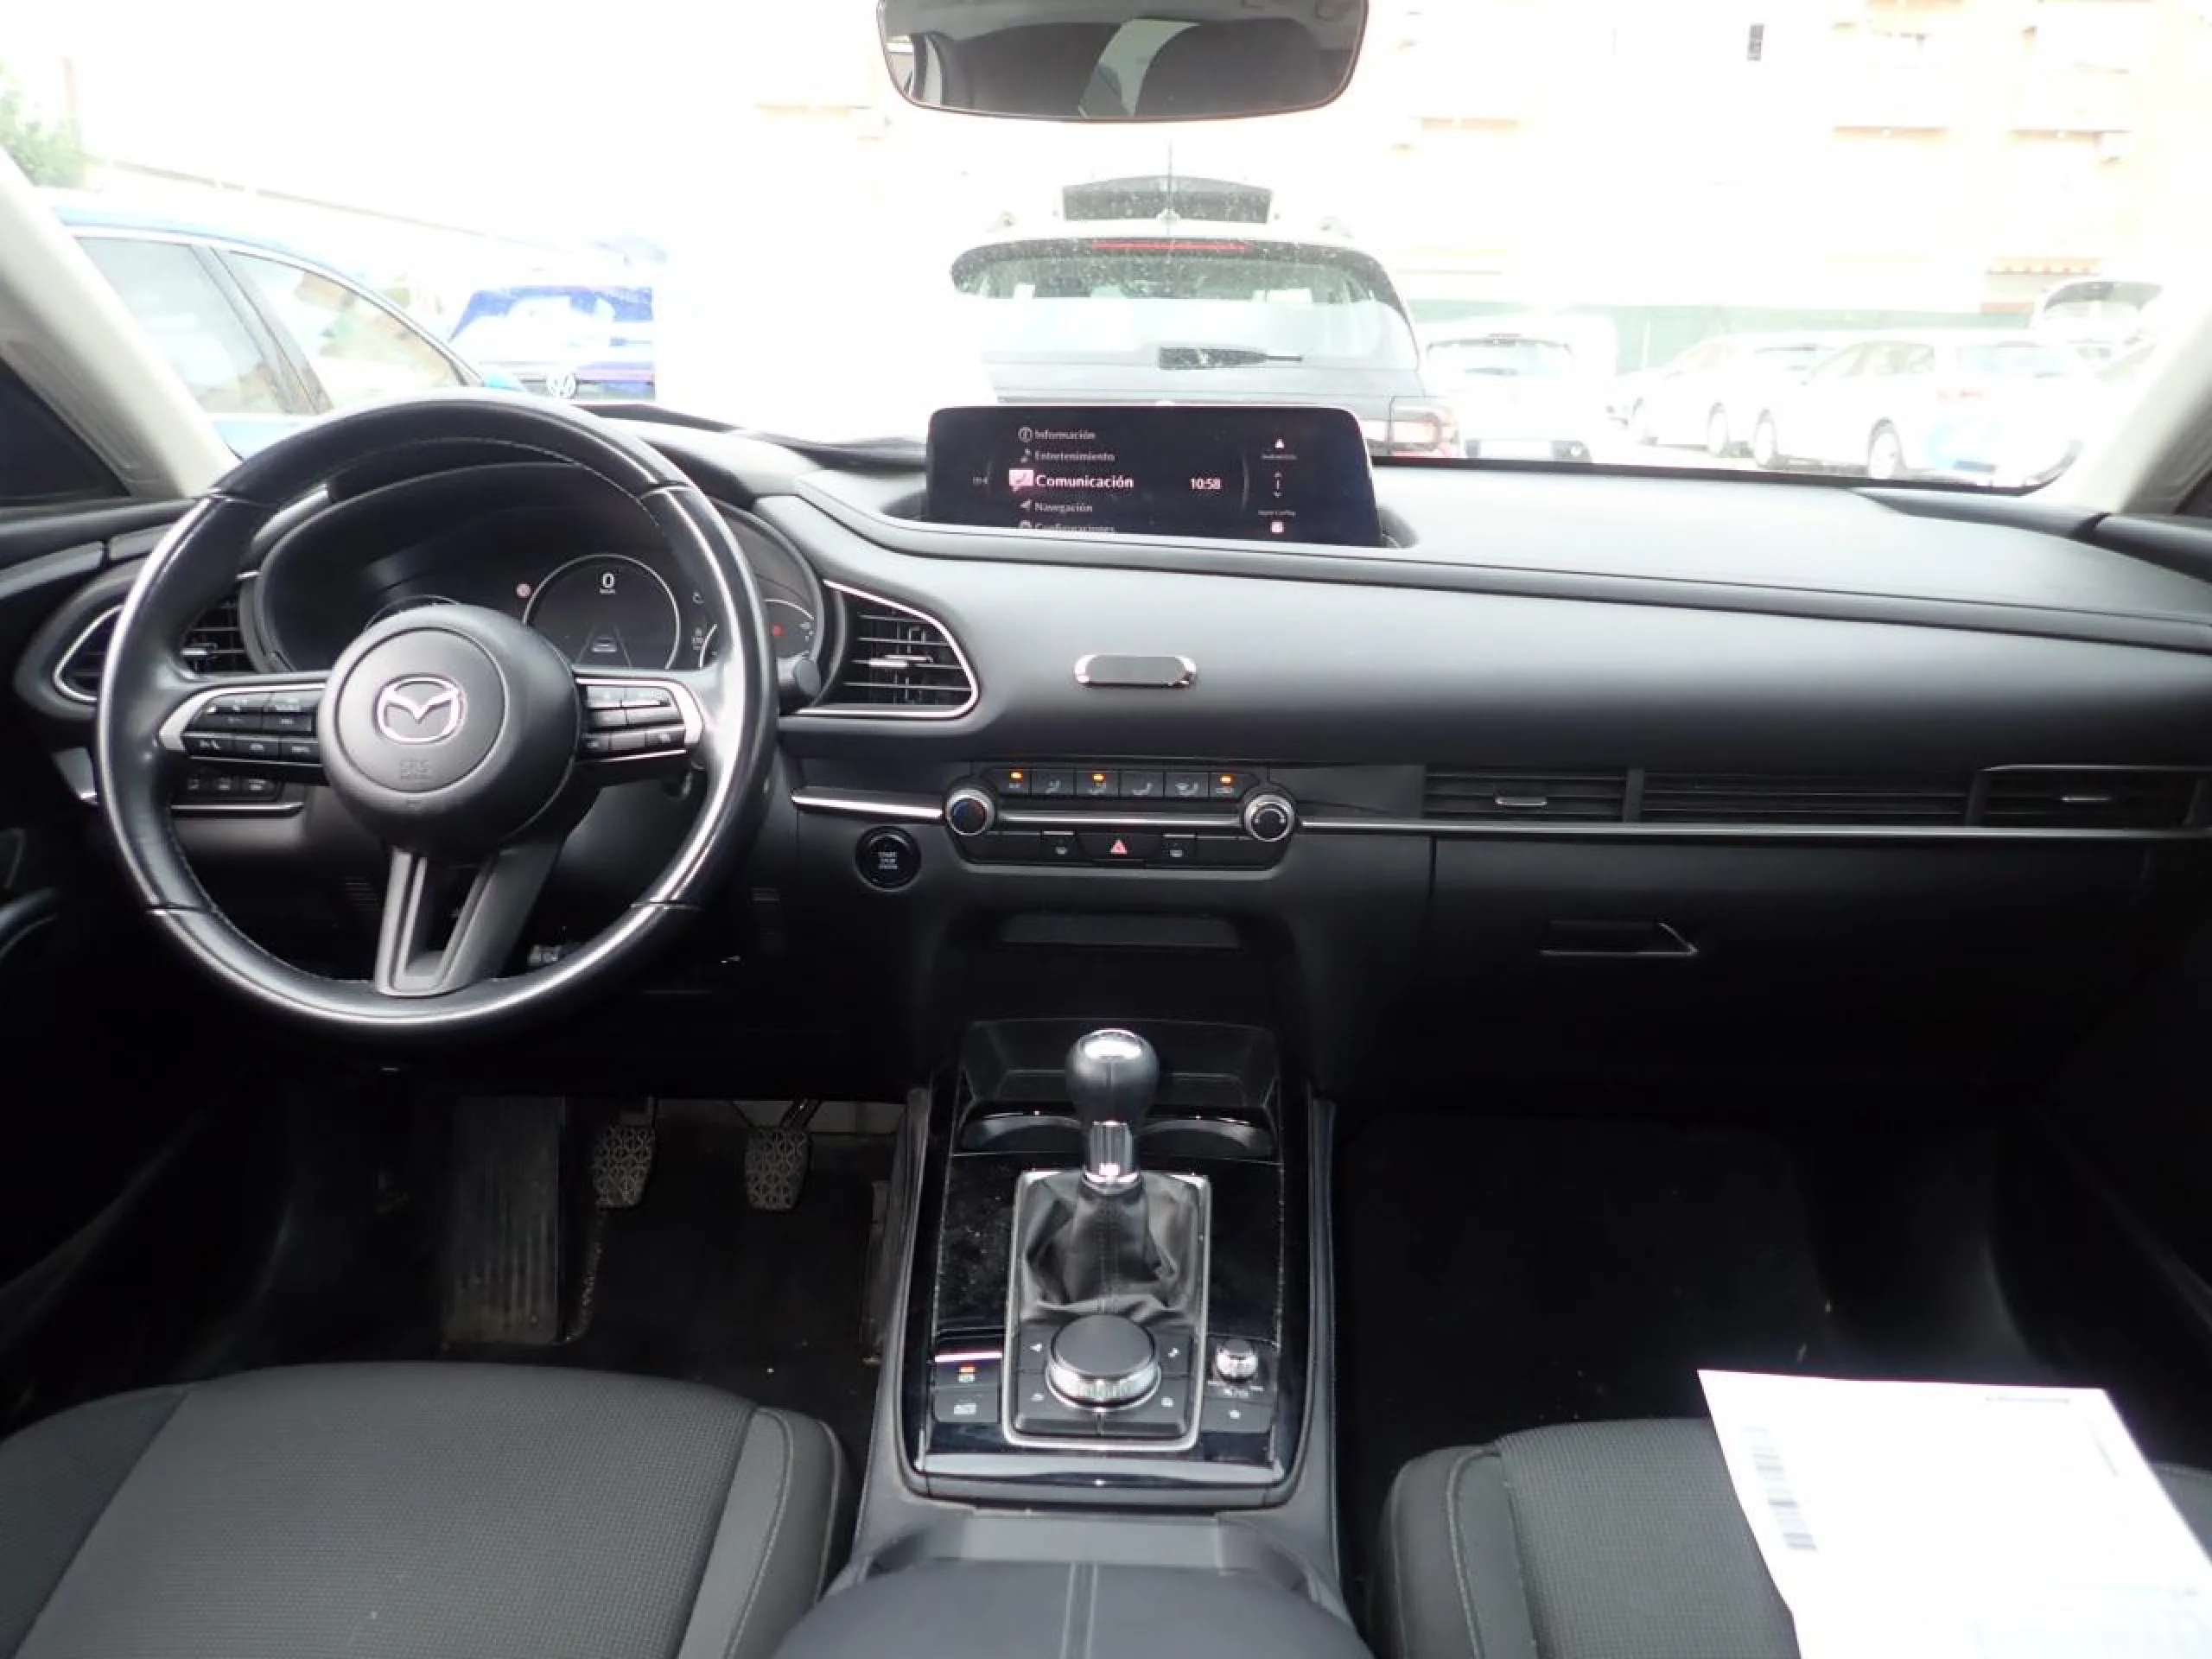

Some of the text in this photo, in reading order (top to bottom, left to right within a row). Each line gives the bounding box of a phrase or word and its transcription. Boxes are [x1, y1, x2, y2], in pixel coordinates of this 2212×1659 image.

[1035, 429, 1096, 440] Información
[1035, 451, 1116, 462] Entretenimiento
[1036, 474, 1135, 488] Comunicación
[1191, 478, 1221, 490] 10:58
[1035, 502, 1093, 513] Navegación
[602, 573, 614, 588] 0
